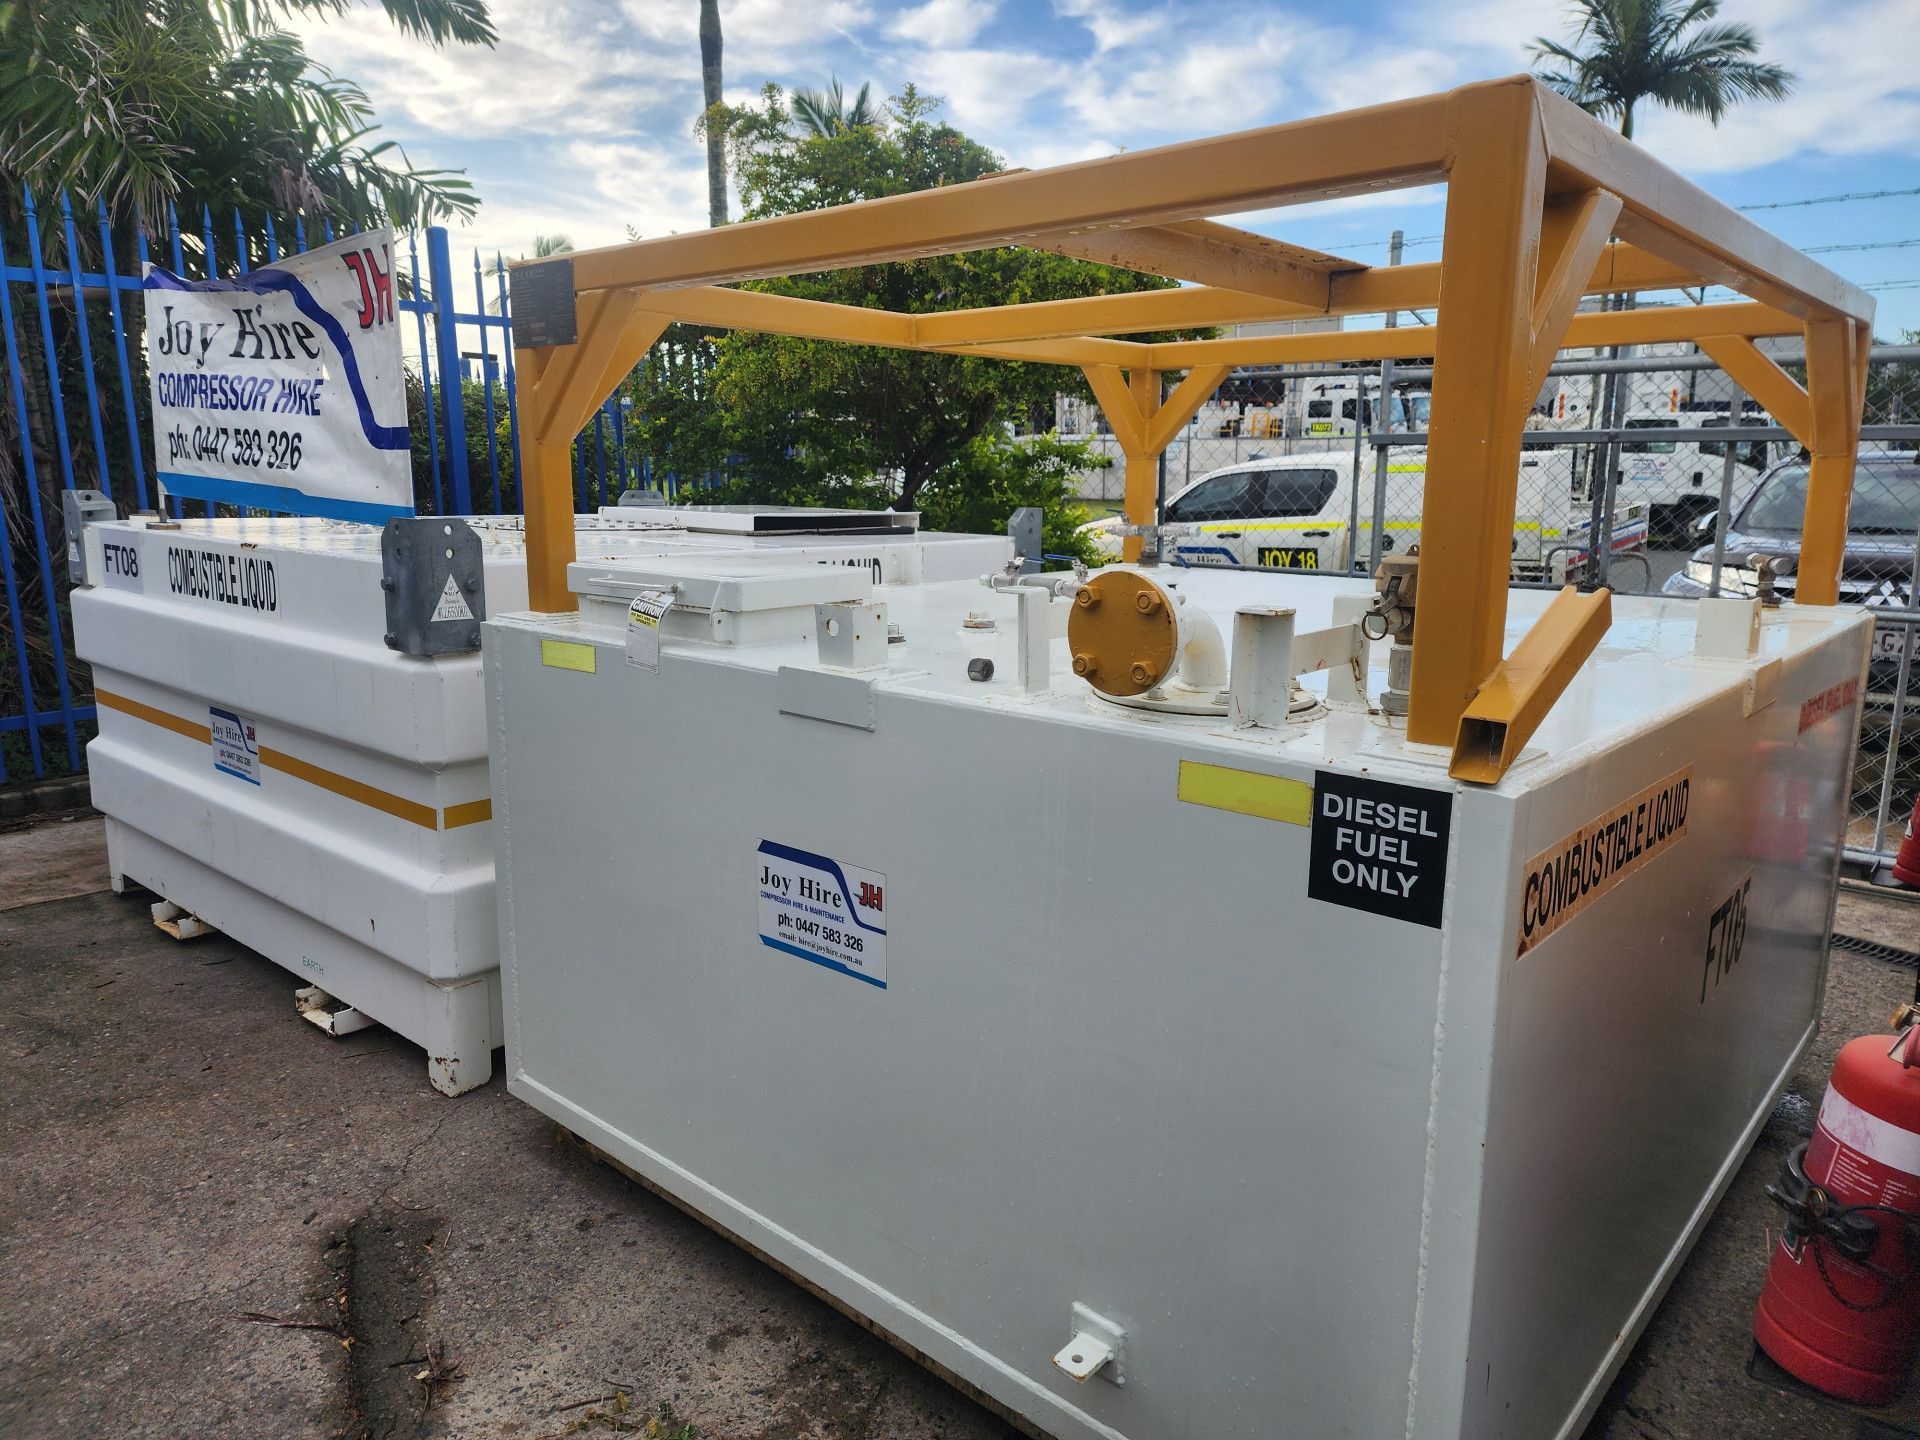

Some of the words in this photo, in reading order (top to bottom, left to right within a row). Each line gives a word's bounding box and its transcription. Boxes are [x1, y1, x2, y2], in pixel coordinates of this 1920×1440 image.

[340, 243, 394, 330] JH
[158, 306, 225, 369] Joy
[229, 304, 321, 360] Hire
[158, 372, 275, 412] COMPRESSOR
[272, 378, 324, 416] HIRE
[168, 423, 192, 466] ph:
[192, 425, 230, 464] 0447
[231, 429, 264, 468] 583
[266, 430, 302, 471] 326
[103, 543, 139, 578] FT08
[168, 546, 239, 605] COMBUSTIBLE
[238, 557, 277, 612] LIQUID
[1262, 550, 1293, 569] JOY
[1297, 552, 1316, 570] 18
[632, 600, 662, 618] CAUTION
[212, 722, 223, 738] Joy
[226, 726, 241, 742] Hire
[1322, 792, 1438, 838] DIESEL
[1335, 826, 1418, 867] FUEL
[1523, 803, 1646, 938] COMBUSTIBLE
[1645, 778, 1690, 850] LIQUID
[760, 866, 791, 896] Joy
[799, 876, 842, 908] Hire
[859, 881, 883, 912] JH
[1332, 859, 1419, 898] ONLY
[760, 890, 792, 906] COMPRESSOR
[792, 900, 804, 910] HIRE
[809, 906, 845, 924] MAINTENANCE
[778, 913, 793, 928] ph:
[795, 917, 820, 936] 0447
[822, 926, 841, 945] 583
[844, 933, 863, 952] 326
[778, 931, 797, 942] email:
[798, 936, 863, 966] hire@joyhire.com.au
[1700, 877, 1751, 1005] FT05
[302, 955, 324, 976] EARTH
